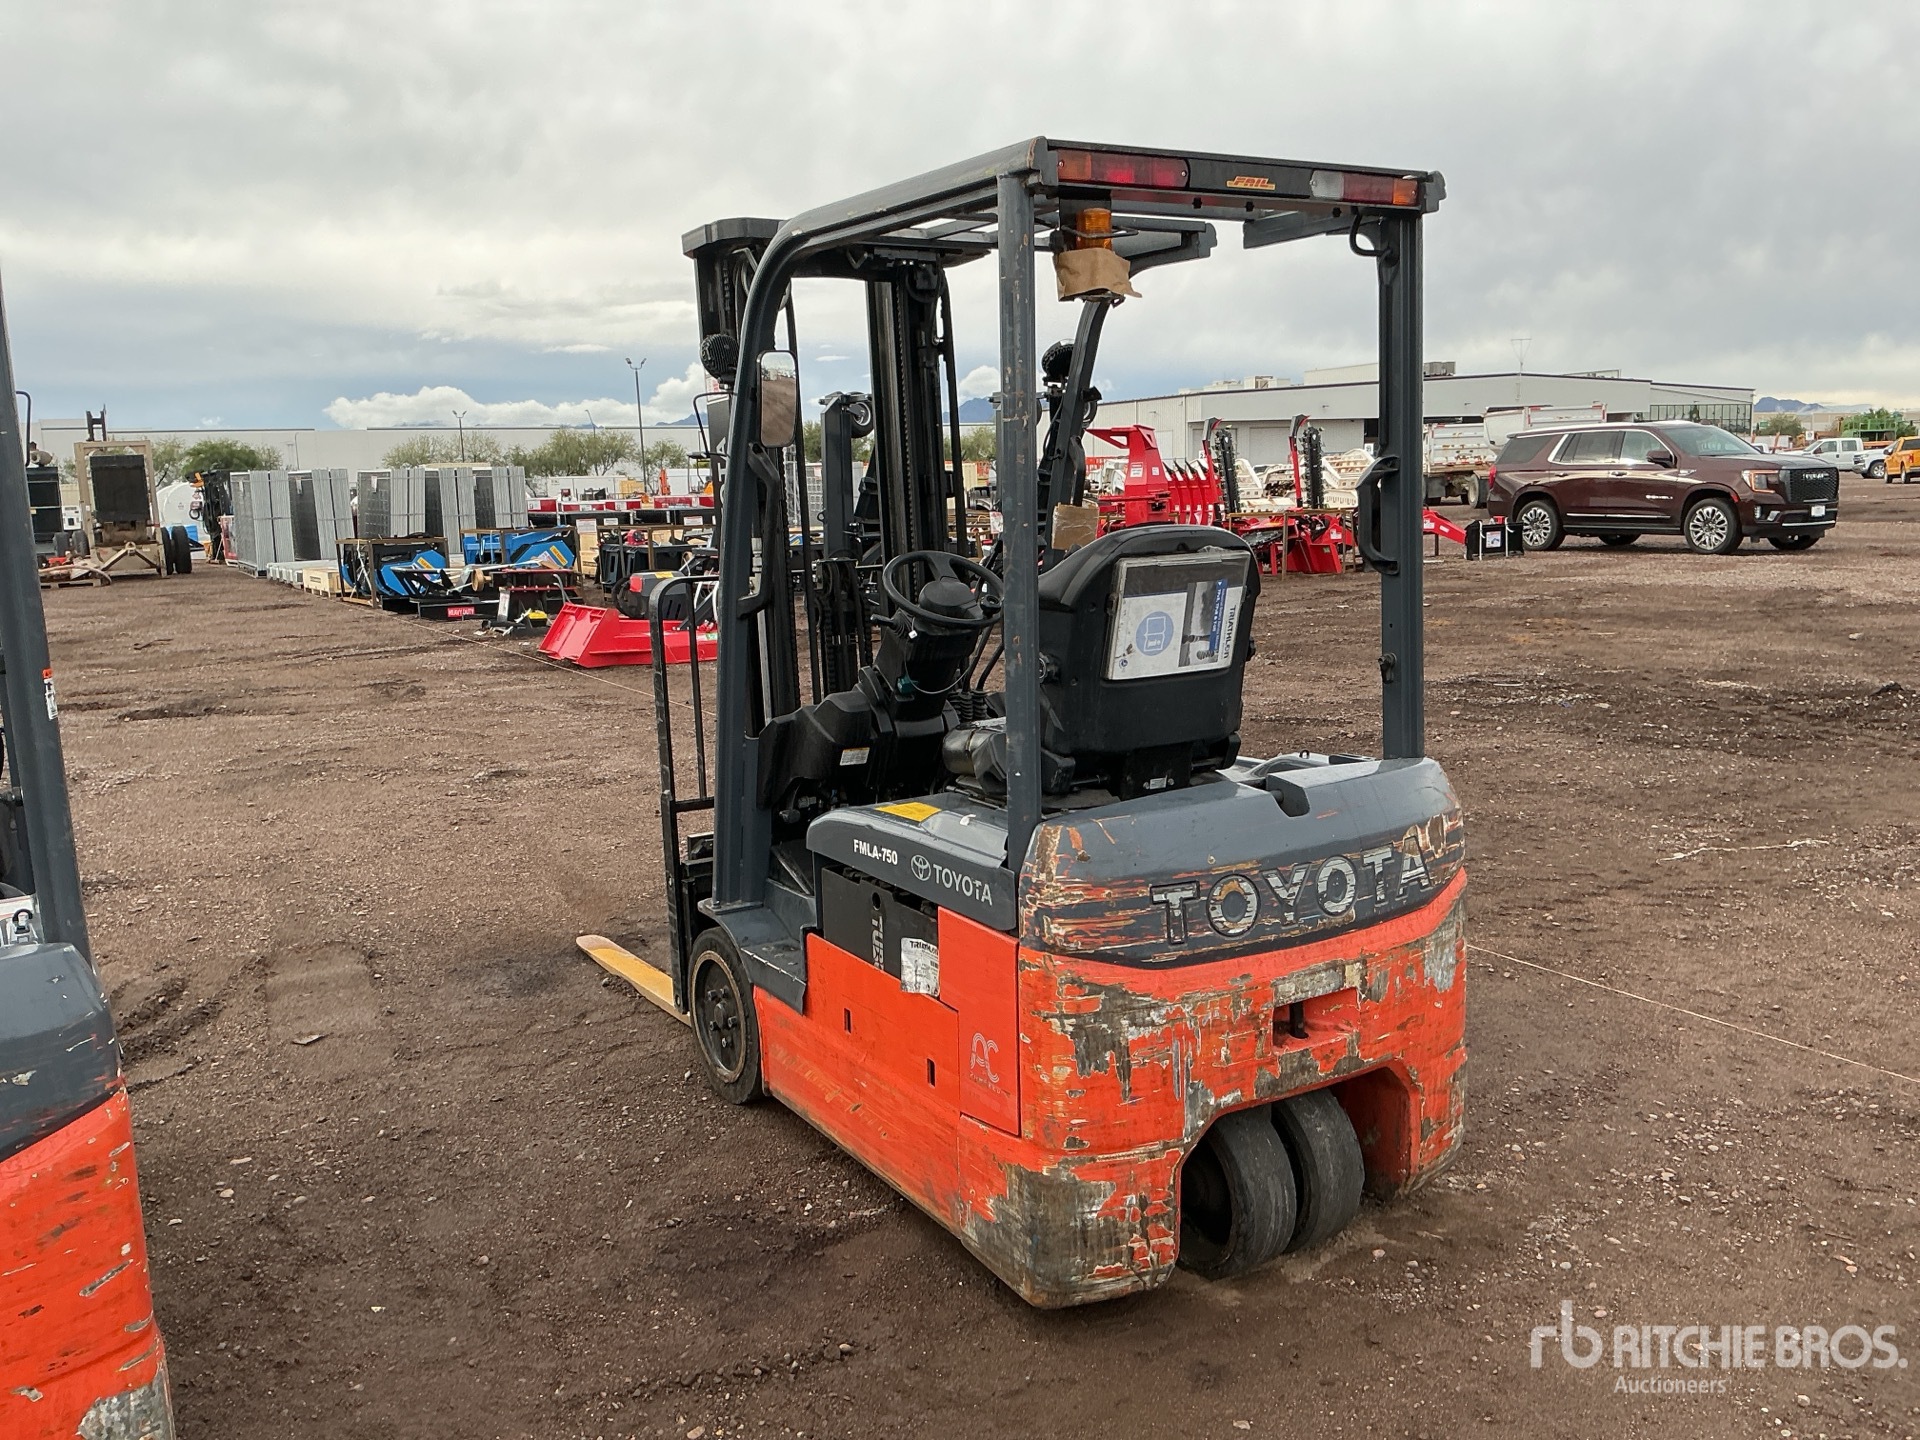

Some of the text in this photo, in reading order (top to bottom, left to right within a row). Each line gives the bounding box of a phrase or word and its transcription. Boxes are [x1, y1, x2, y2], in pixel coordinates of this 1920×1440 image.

[1224, 605, 1236, 658] TRIATHLON
[853, 839, 898, 865] FMLA-750
[933, 863, 993, 905] TOYOTA
[1150, 837, 1434, 945] TOYOTA
